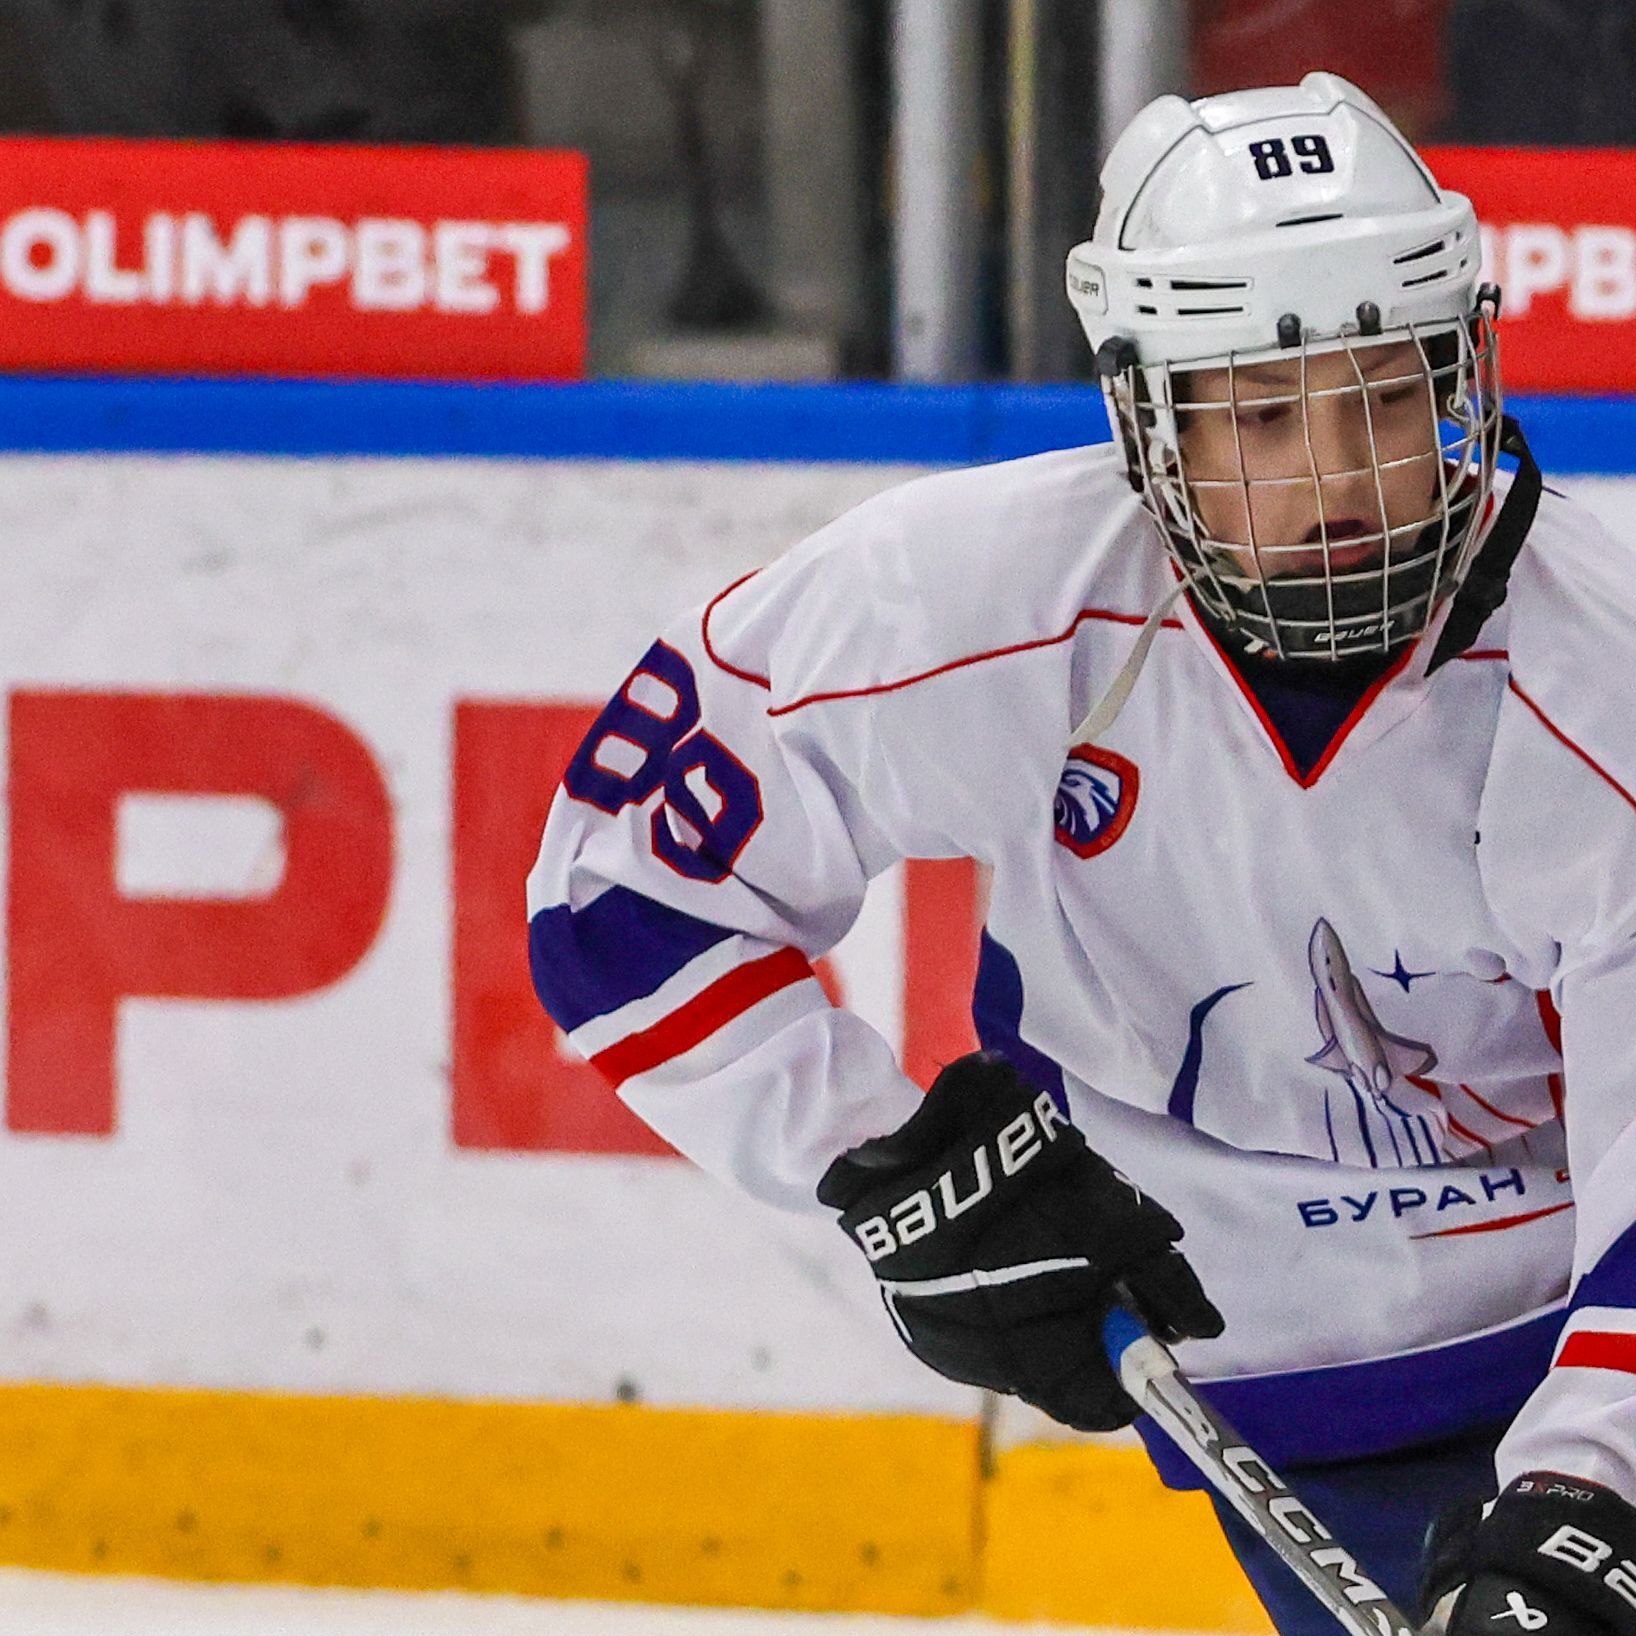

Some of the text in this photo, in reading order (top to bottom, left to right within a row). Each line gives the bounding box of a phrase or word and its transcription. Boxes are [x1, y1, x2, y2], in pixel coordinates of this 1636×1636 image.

[1249, 134, 1335, 181] 89
[2, 207, 570, 316] OLIMPBET
[562, 637, 764, 885] 89
[1297, 1168, 1526, 1228] БУРАН
[1221, 1444, 1389, 1606] CCM
